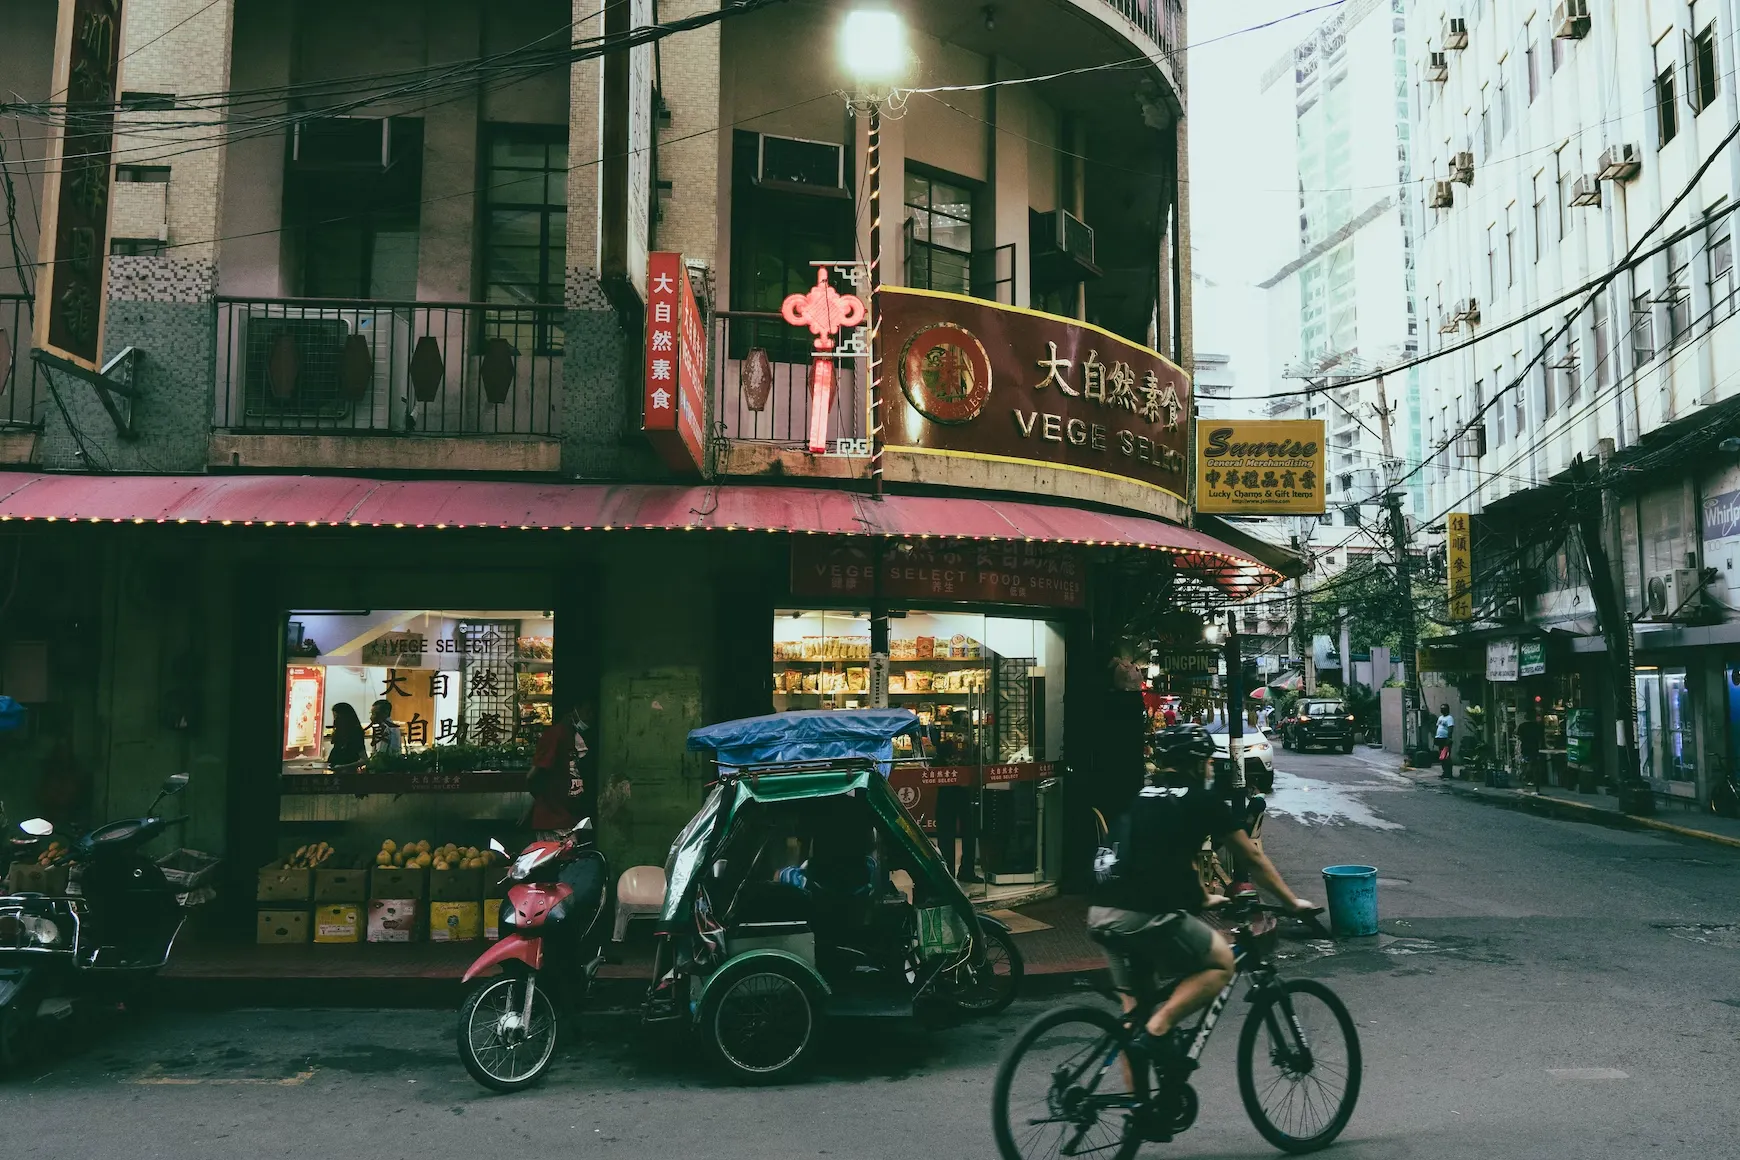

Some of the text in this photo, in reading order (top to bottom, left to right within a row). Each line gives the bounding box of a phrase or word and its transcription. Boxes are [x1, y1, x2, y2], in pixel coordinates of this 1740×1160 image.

[651, 272, 673, 410] 大自然素食
[1033, 340, 1184, 432] 大自然素食
[1013, 408, 1187, 476] VEGE SELECT
[1204, 428, 1318, 458] Sunrise
[1207, 459, 1314, 469] General Merchandising
[1208, 490, 1231, 499] Lucky
[1234, 490, 1262, 498] Charms
[1275, 490, 1290, 498] Gift
[1292, 490, 1313, 499] Items
[815, 564, 1080, 593] VEGE SELECT FOOD SERVICES
[389, 639, 428, 653] VEGE
[436, 639, 492, 653] SELECT
[1164, 656, 1209, 671] ONGPIN
[380, 668, 502, 699] 大自然
